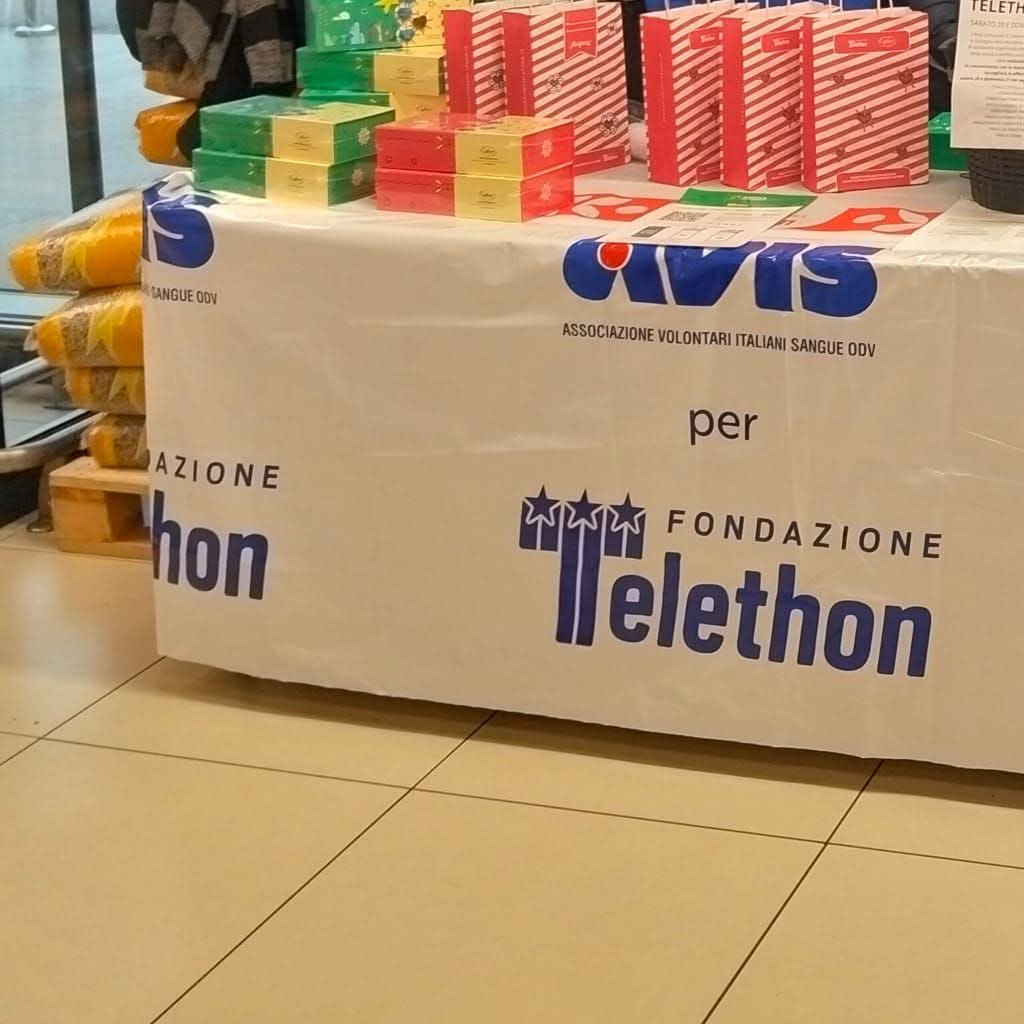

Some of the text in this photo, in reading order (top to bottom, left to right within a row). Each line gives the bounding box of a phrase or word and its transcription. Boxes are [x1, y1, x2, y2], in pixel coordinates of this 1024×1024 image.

[151, 285, 218, 305] SANGUE ODV
[562, 238, 884, 318] AVIS
[562, 321, 876, 358] ASSOCIAZIONE VOLONTARI ITALIANI SANGUE ODV
[688, 407, 759, 446] per
[667, 509, 943, 560] FONDAZIONE
[518, 484, 933, 678] Telethon
